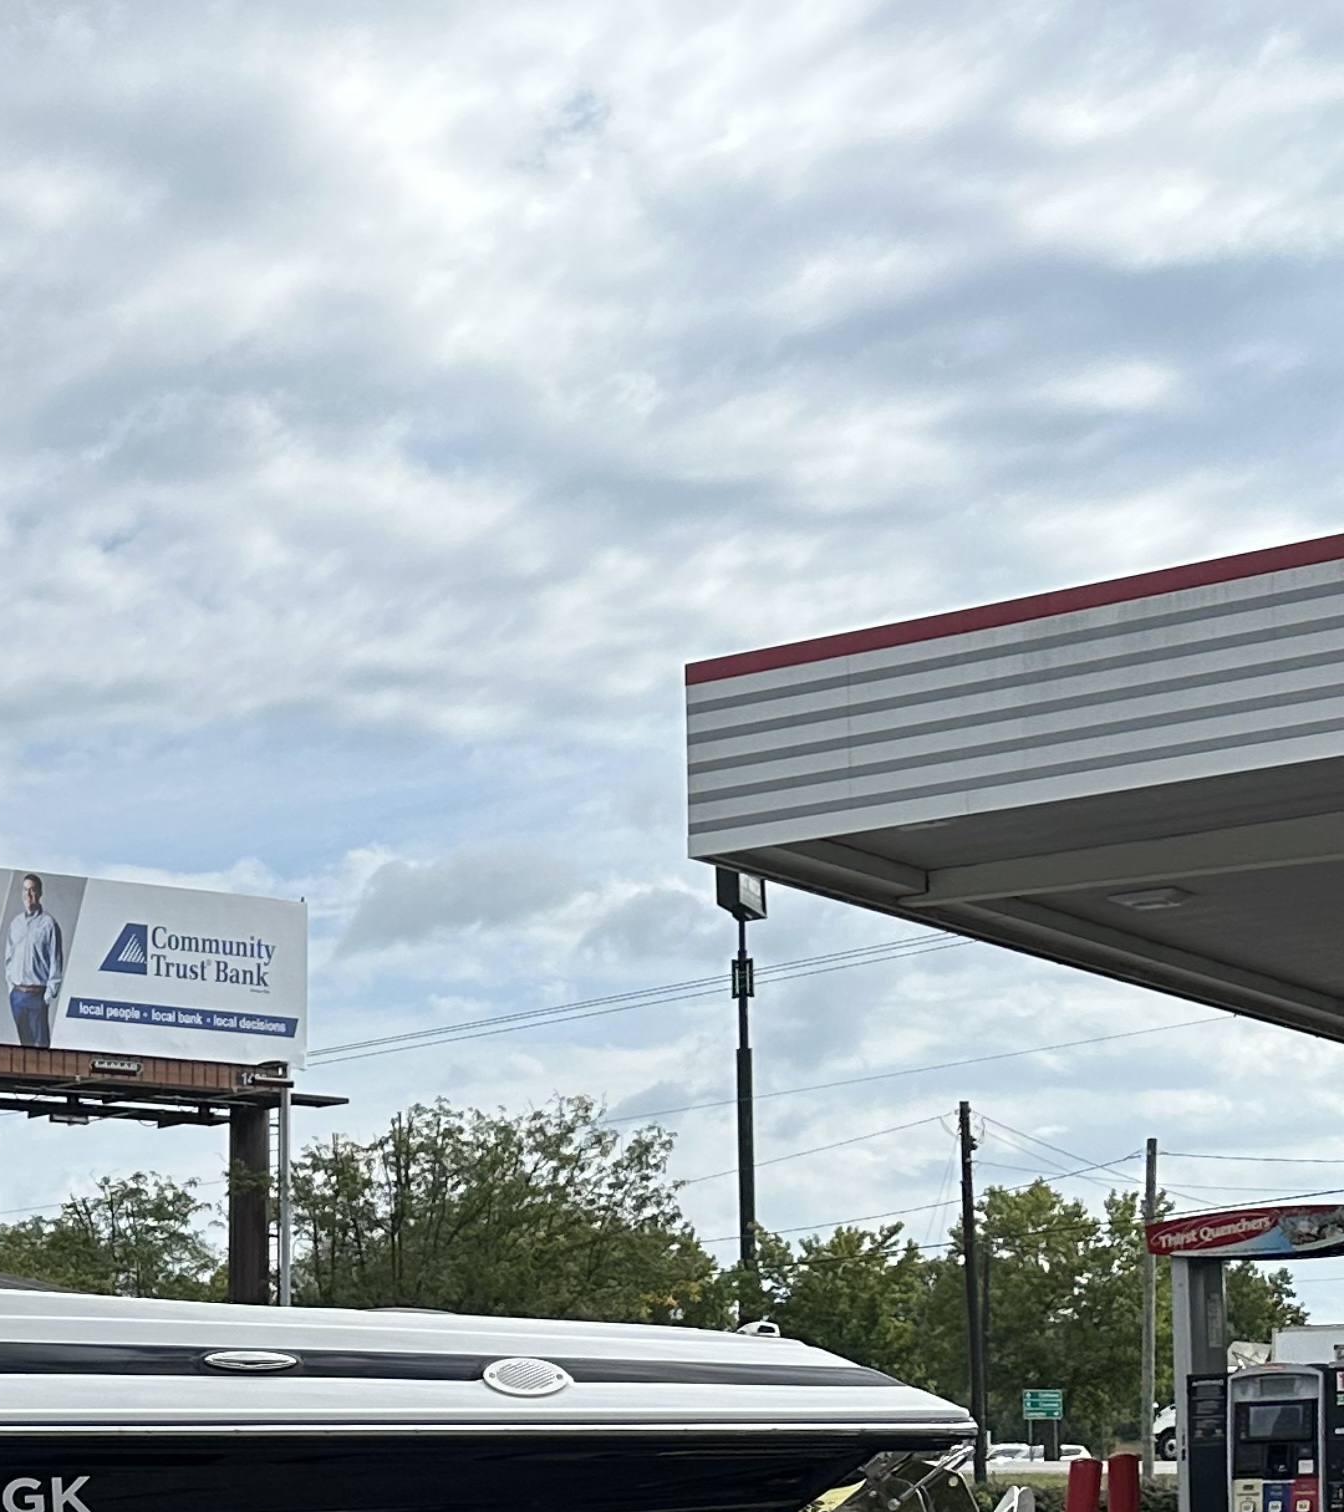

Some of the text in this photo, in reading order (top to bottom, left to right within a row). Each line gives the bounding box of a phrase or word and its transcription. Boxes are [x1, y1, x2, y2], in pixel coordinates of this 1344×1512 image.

[151, 926, 276, 966] Community
[151, 954, 269, 987] Trust Bank
[79, 1002, 286, 1033] local people local bank local decisions
[1158, 1216, 1271, 1248] Thirst Quenchers
